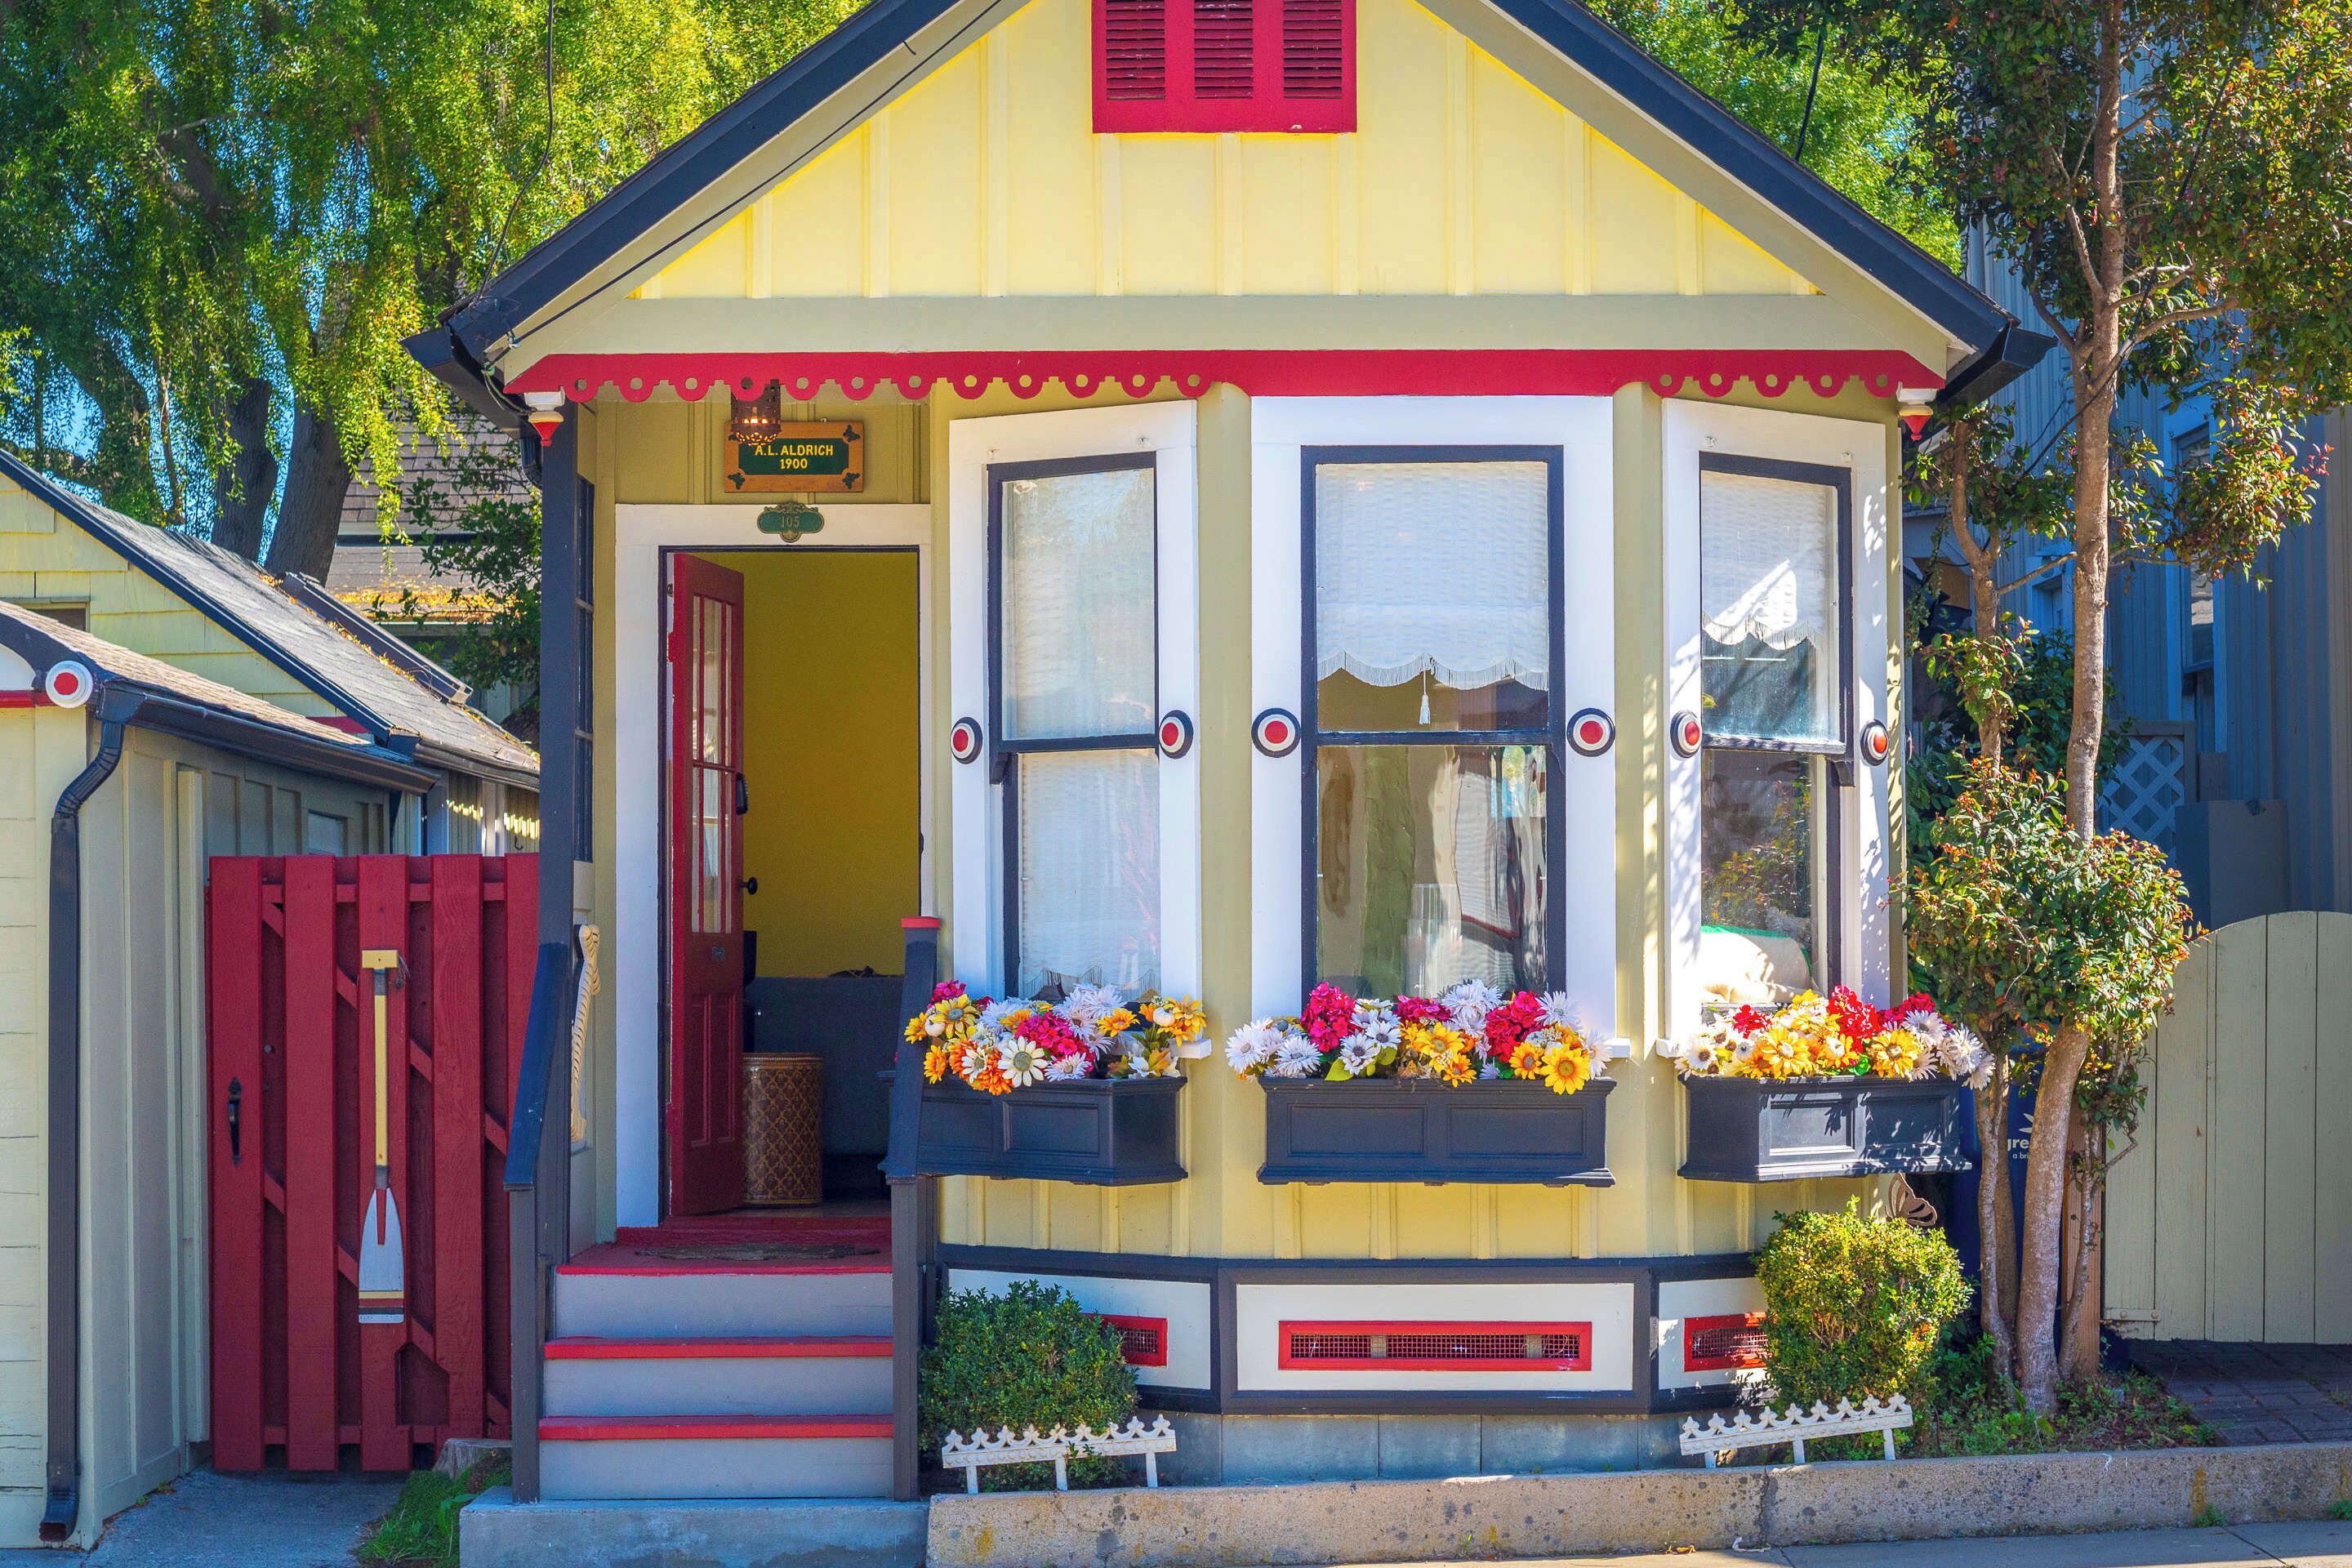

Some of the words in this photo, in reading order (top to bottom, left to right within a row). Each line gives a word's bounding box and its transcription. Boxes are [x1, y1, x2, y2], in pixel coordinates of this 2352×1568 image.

[755, 444, 778, 456] A.L.
[781, 444, 834, 456] ALDRICH
[780, 458, 808, 470] 1900
